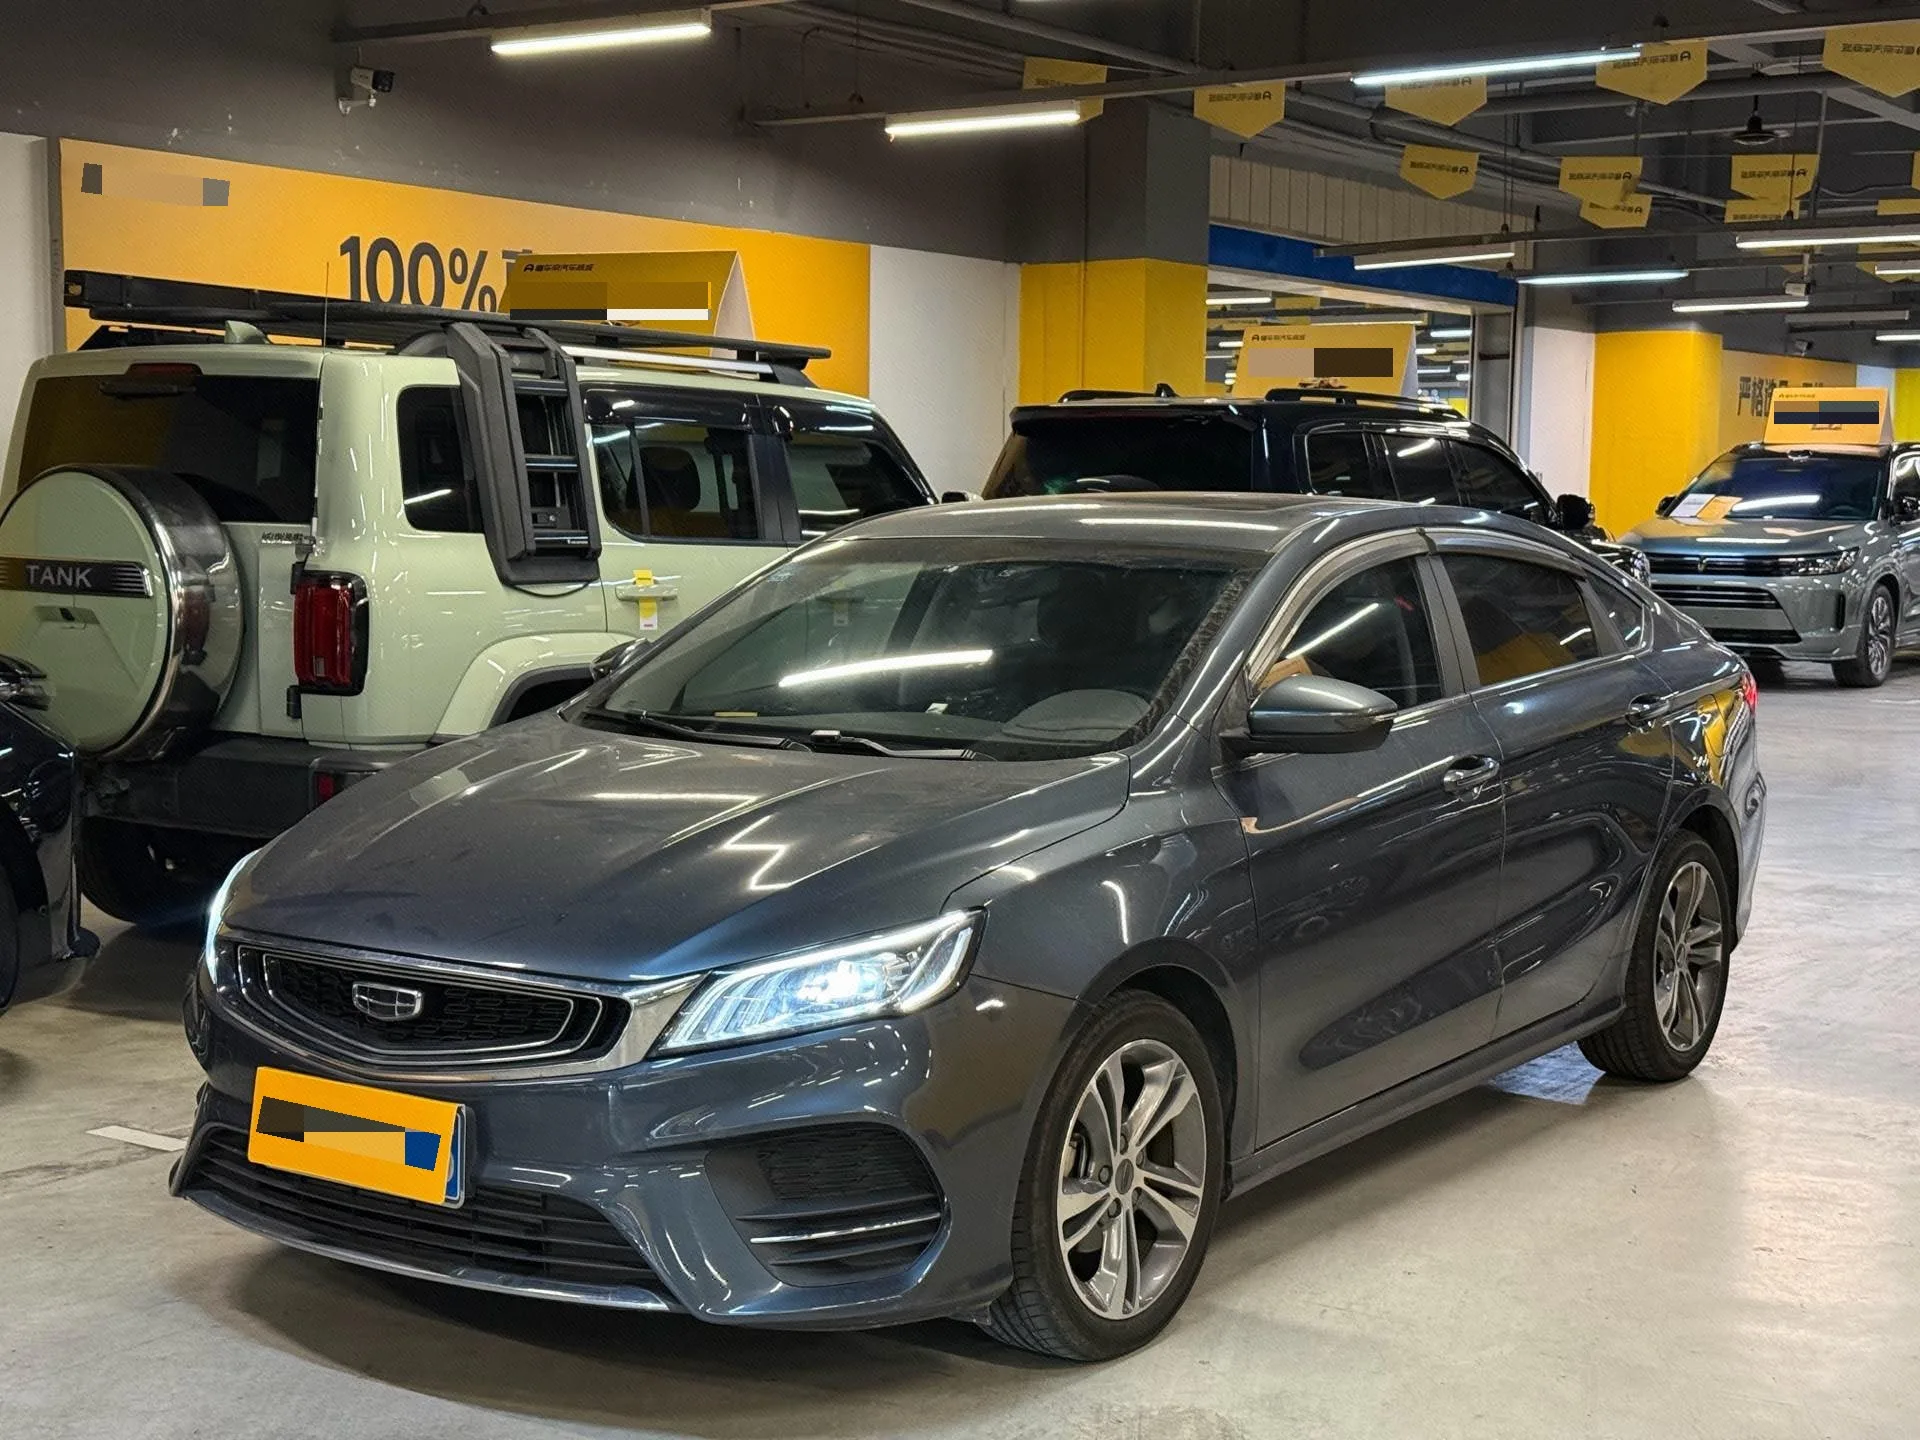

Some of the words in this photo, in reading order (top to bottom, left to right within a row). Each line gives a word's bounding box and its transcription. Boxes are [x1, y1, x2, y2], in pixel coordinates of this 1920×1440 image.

[339, 235, 533, 313] 100%
[1737, 376, 1789, 417] 严格
[25, 564, 93, 588] TANK
